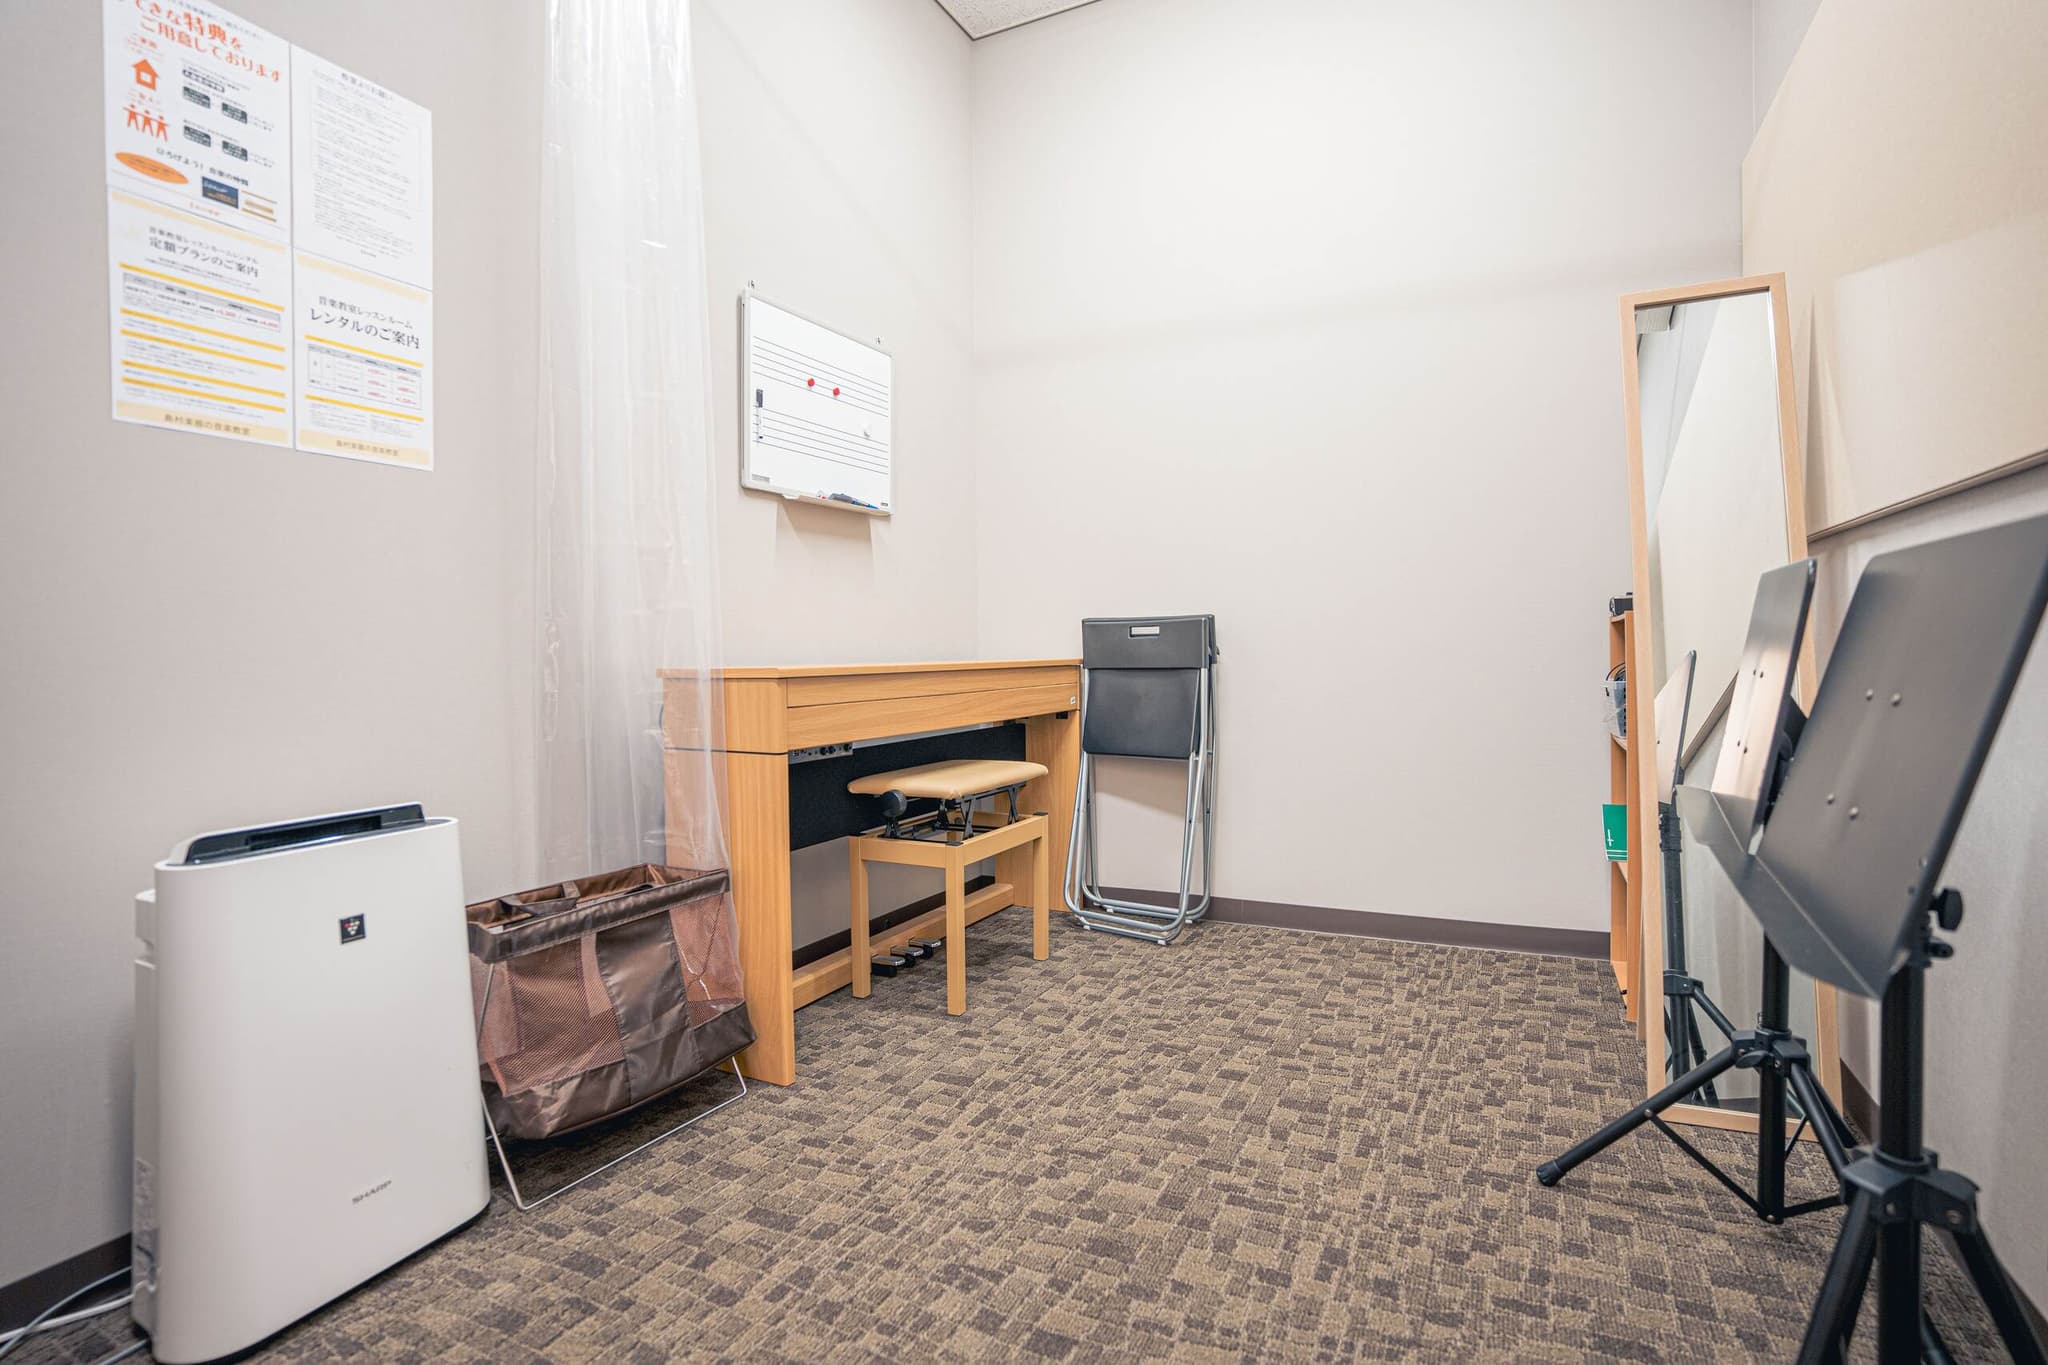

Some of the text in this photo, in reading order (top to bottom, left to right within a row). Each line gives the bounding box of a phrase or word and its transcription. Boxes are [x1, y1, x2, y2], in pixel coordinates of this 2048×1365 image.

[149, 236, 259, 278] 定額プランのご案内
[311, 307, 420, 350] レンタルのご案内
